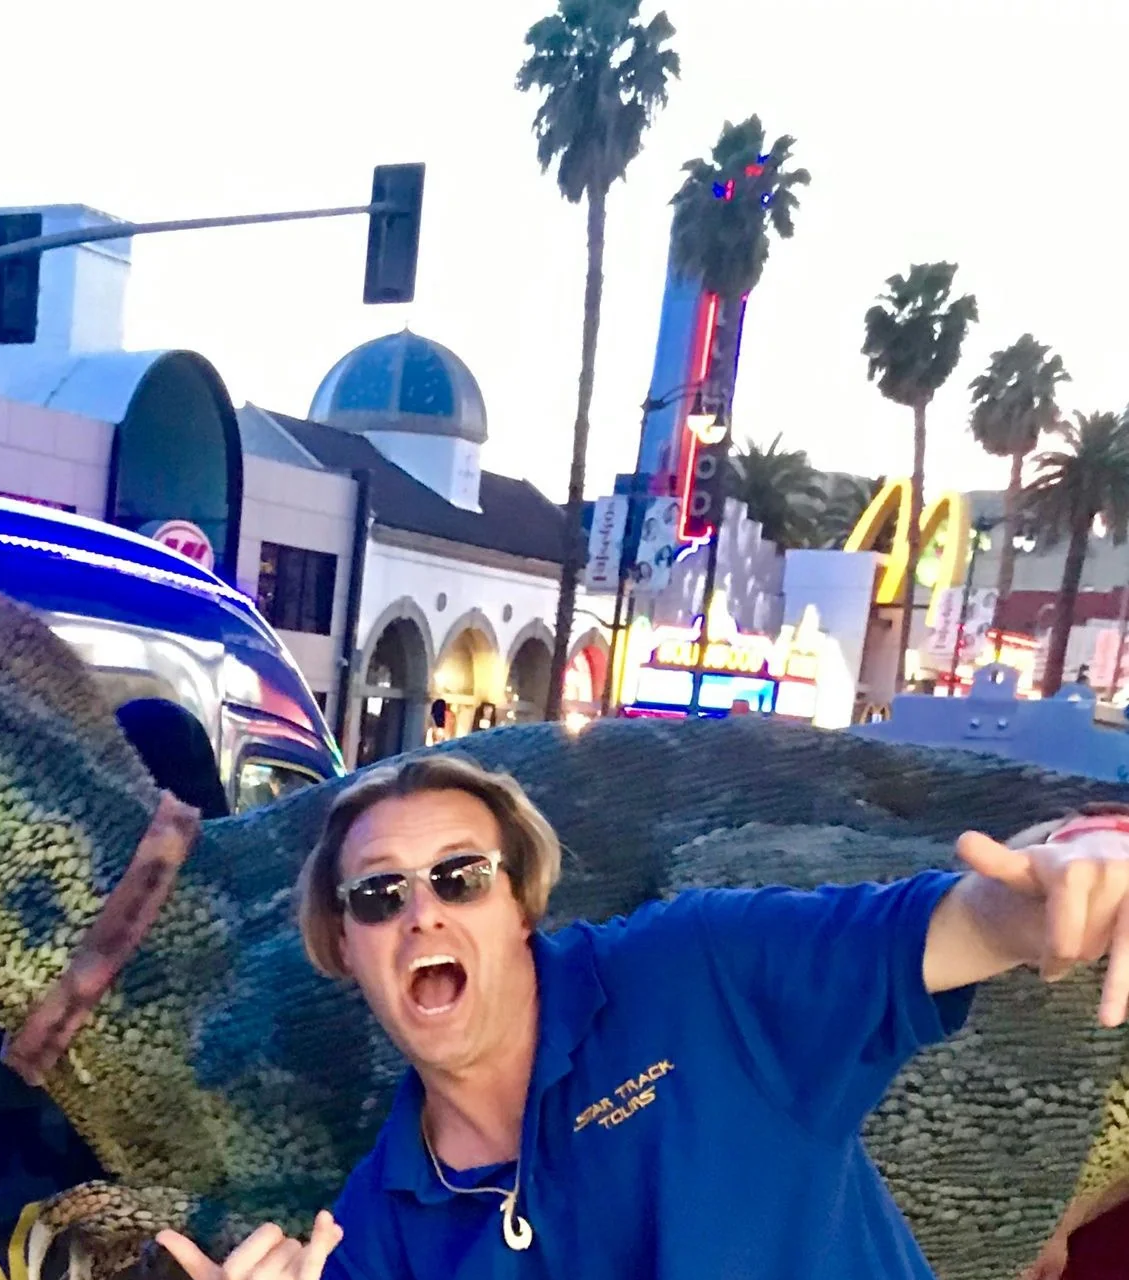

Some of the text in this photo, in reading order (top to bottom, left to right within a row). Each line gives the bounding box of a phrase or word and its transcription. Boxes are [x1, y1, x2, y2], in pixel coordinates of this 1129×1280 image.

[573, 1060, 674, 1133] STAR TRACK
[598, 1084, 656, 1129] TOURS
